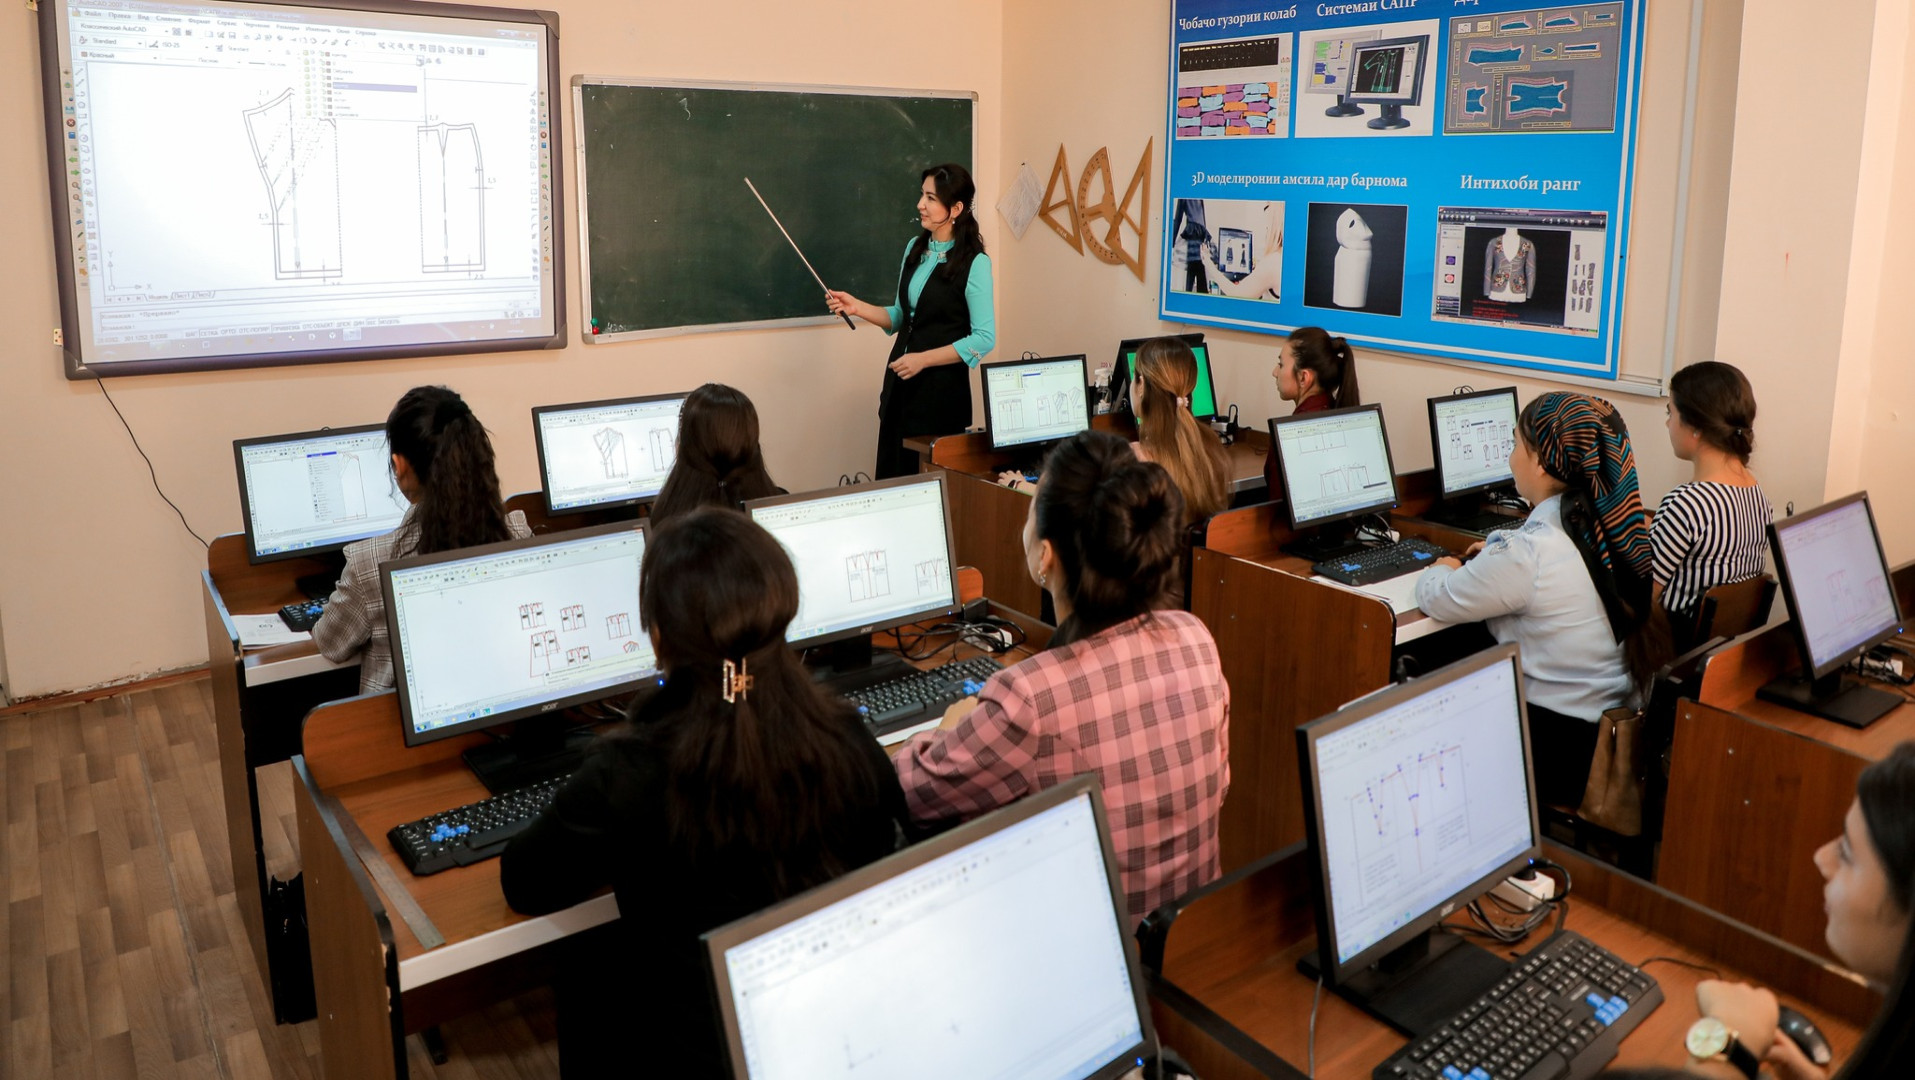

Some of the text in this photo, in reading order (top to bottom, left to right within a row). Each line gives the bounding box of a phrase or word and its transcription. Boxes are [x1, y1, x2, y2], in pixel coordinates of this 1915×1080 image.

[1316, 1, 1378, 17] Системаи
[1217, 13, 1261, 29] гузории
[1191, 171, 1408, 190] 3D моделиронии амсила дар барнома
[1460, 174, 1581, 195] Интихоби ранг
[541, 702, 559, 712] acer
